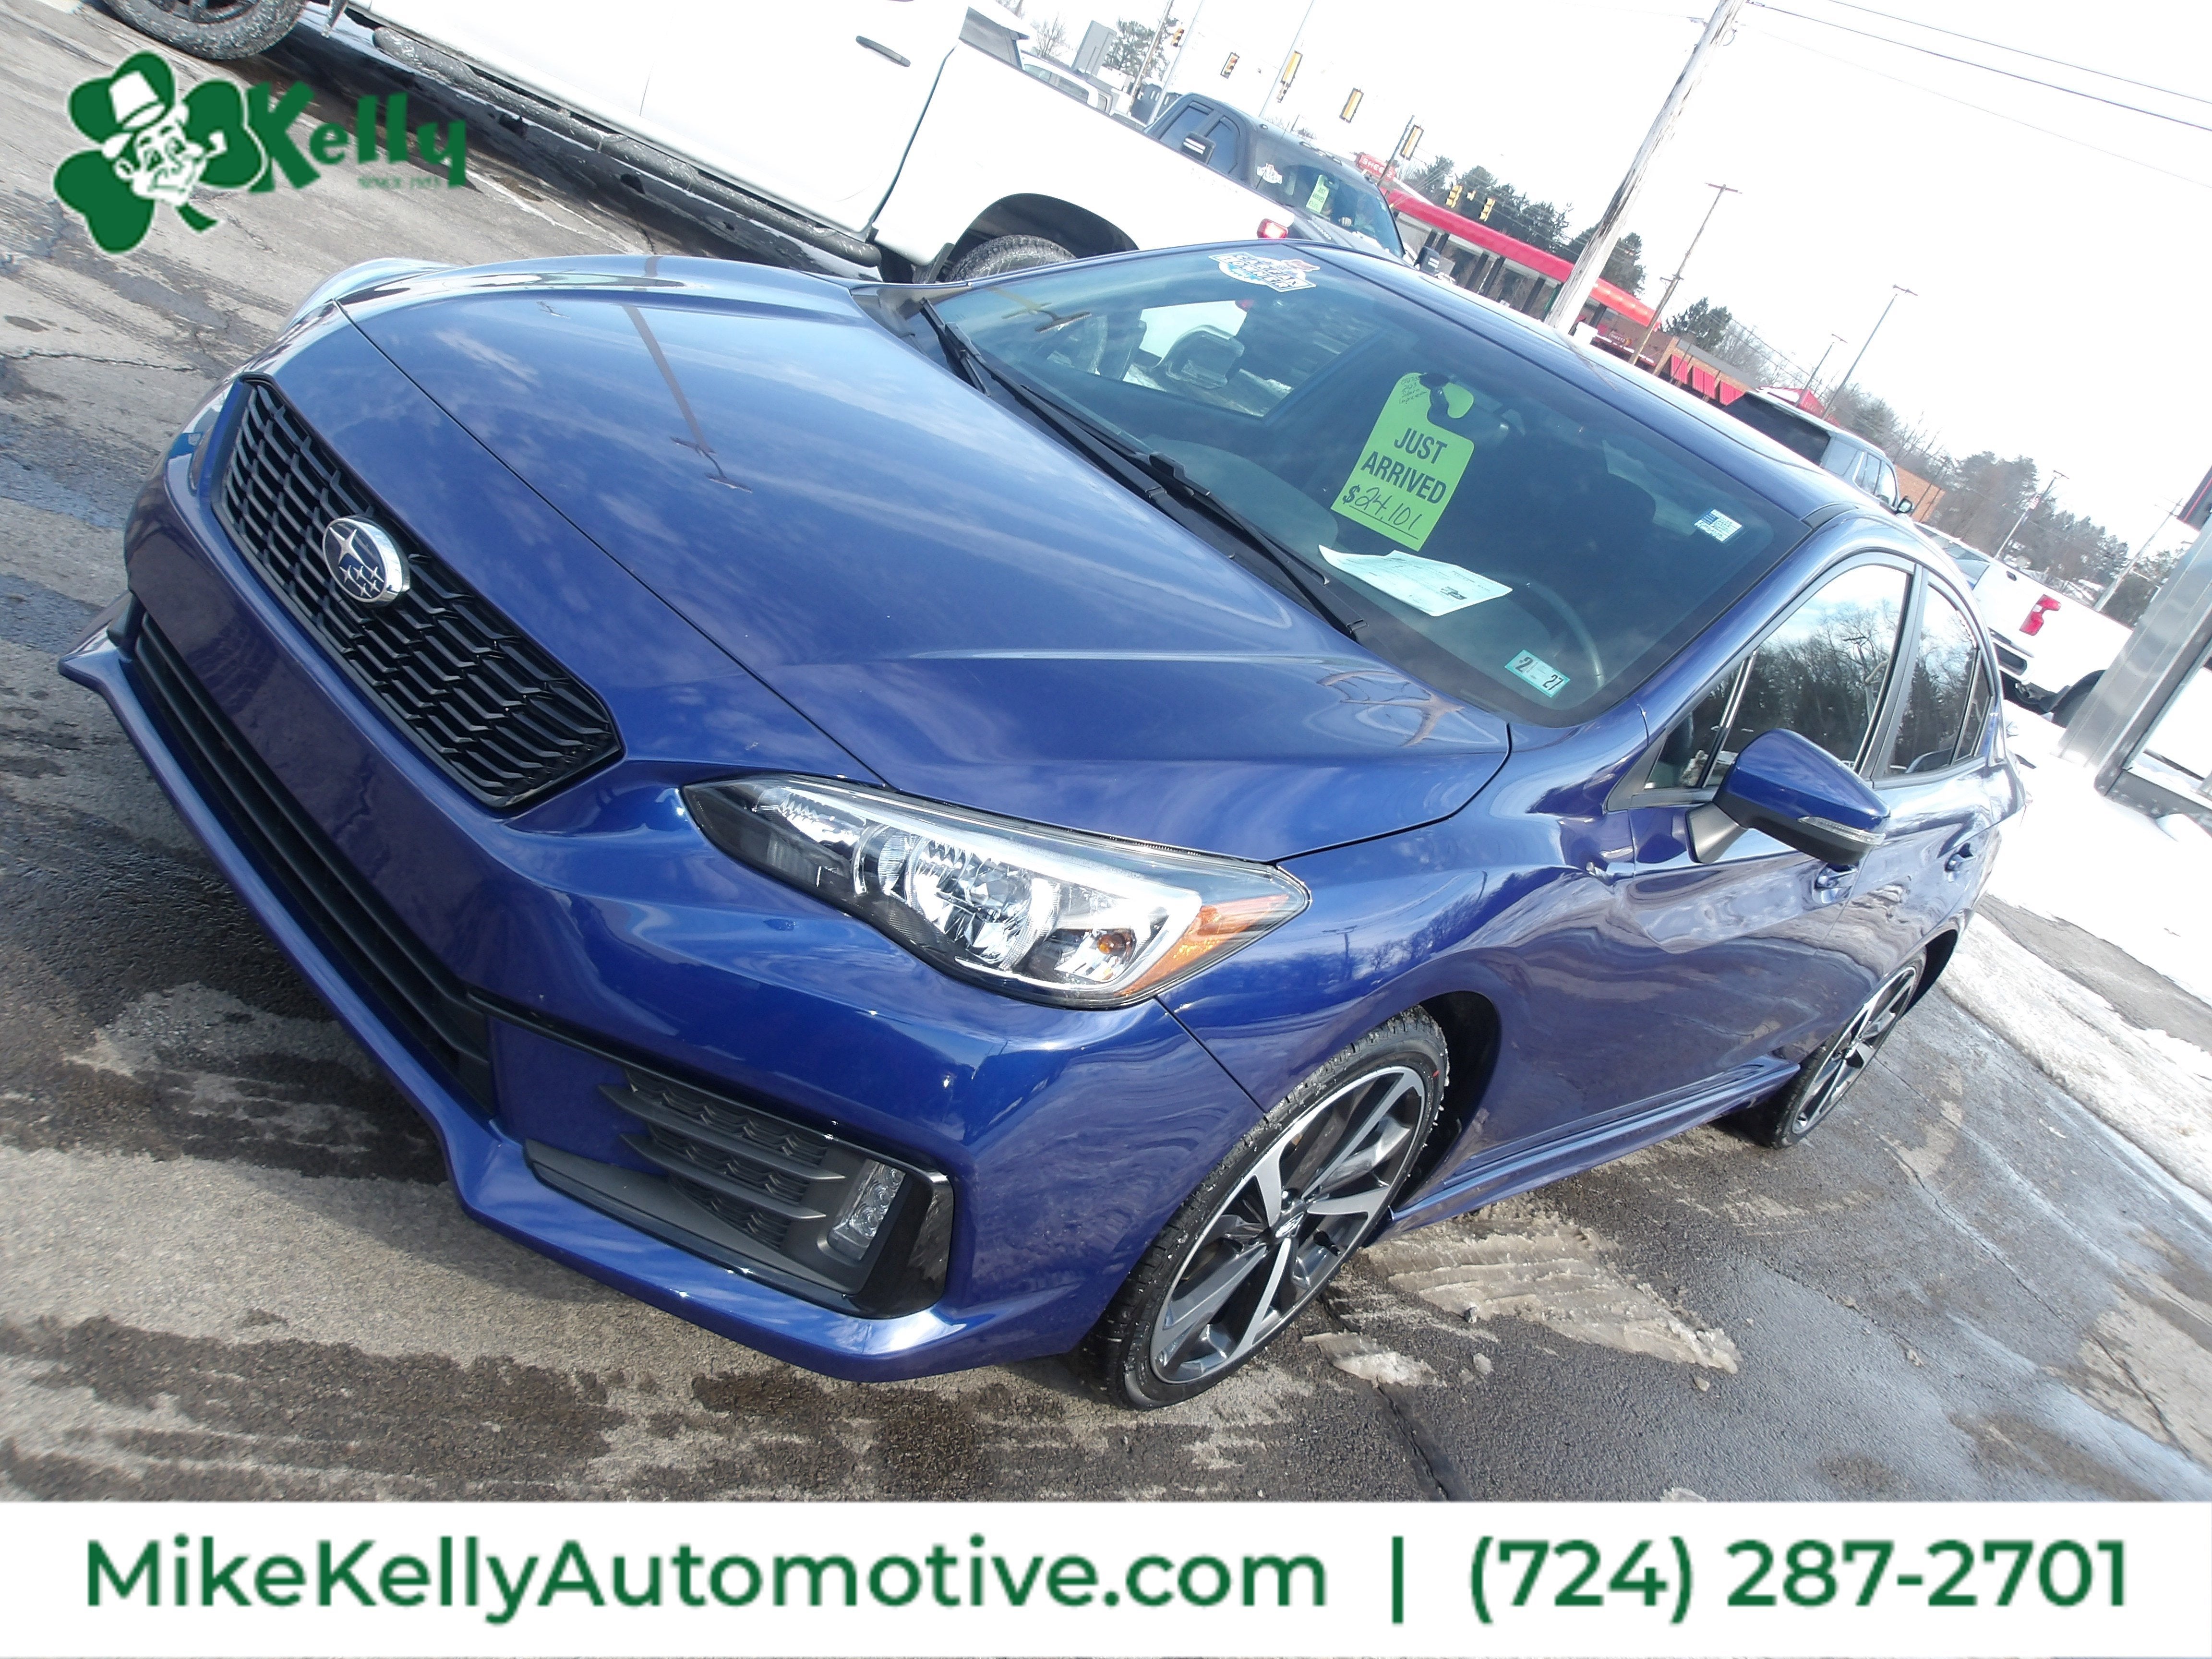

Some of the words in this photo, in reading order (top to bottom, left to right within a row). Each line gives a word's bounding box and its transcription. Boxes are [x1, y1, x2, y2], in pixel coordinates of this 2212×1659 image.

[1362, 157, 1393, 179] SHEEZ
[1394, 427, 1448, 465] JUST
[1360, 451, 1447, 504] ARRIVED
[1515, 656, 1533, 673] 2
[1542, 674, 1564, 691] 27
